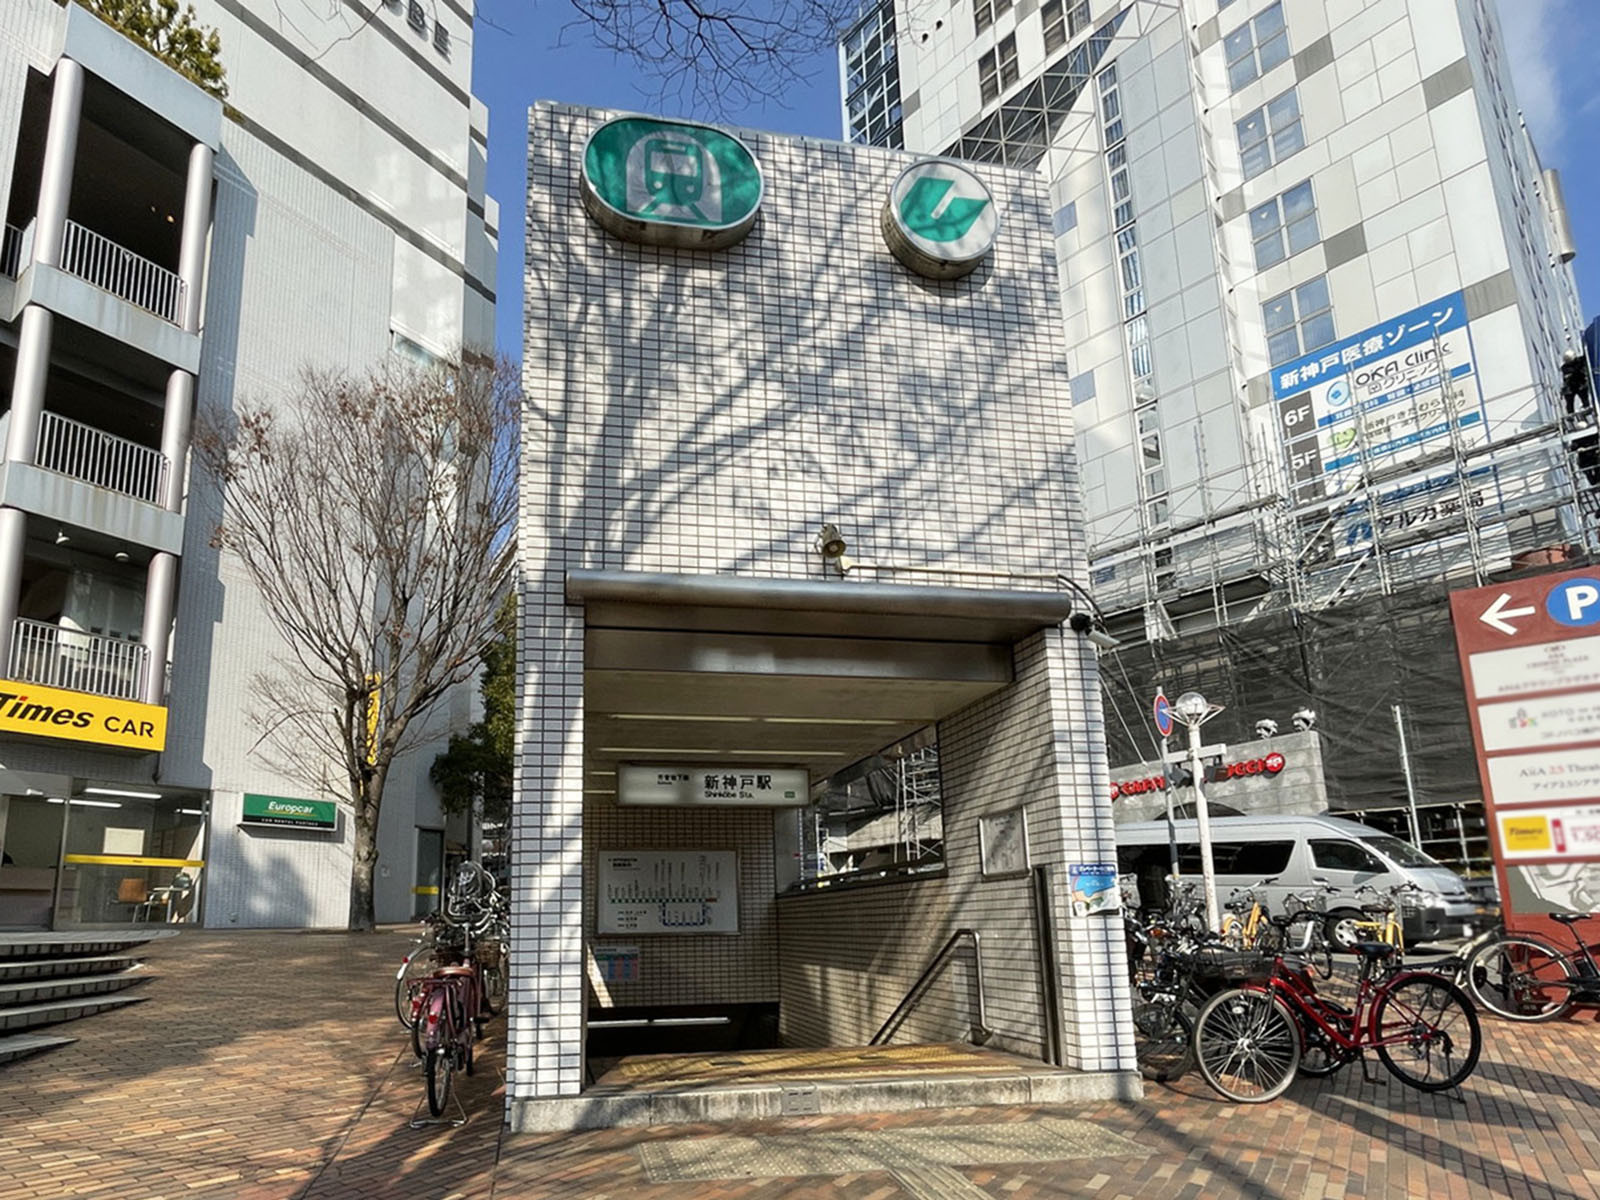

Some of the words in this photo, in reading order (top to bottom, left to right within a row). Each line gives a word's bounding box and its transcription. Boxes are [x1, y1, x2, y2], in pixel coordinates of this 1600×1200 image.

[1280, 307, 1454, 389] 新神戸医療ゾーン
[1356, 360, 1399, 386] OKA
[1284, 405, 1311, 427] 6F
[1291, 449, 1317, 470] 5F
[1565, 585, 1599, 621] P
[0, 692, 94, 728] Times
[104, 716, 155, 738] CAR
[704, 775, 772, 790] 新神戸駅
[268, 801, 315, 815] Europcar
